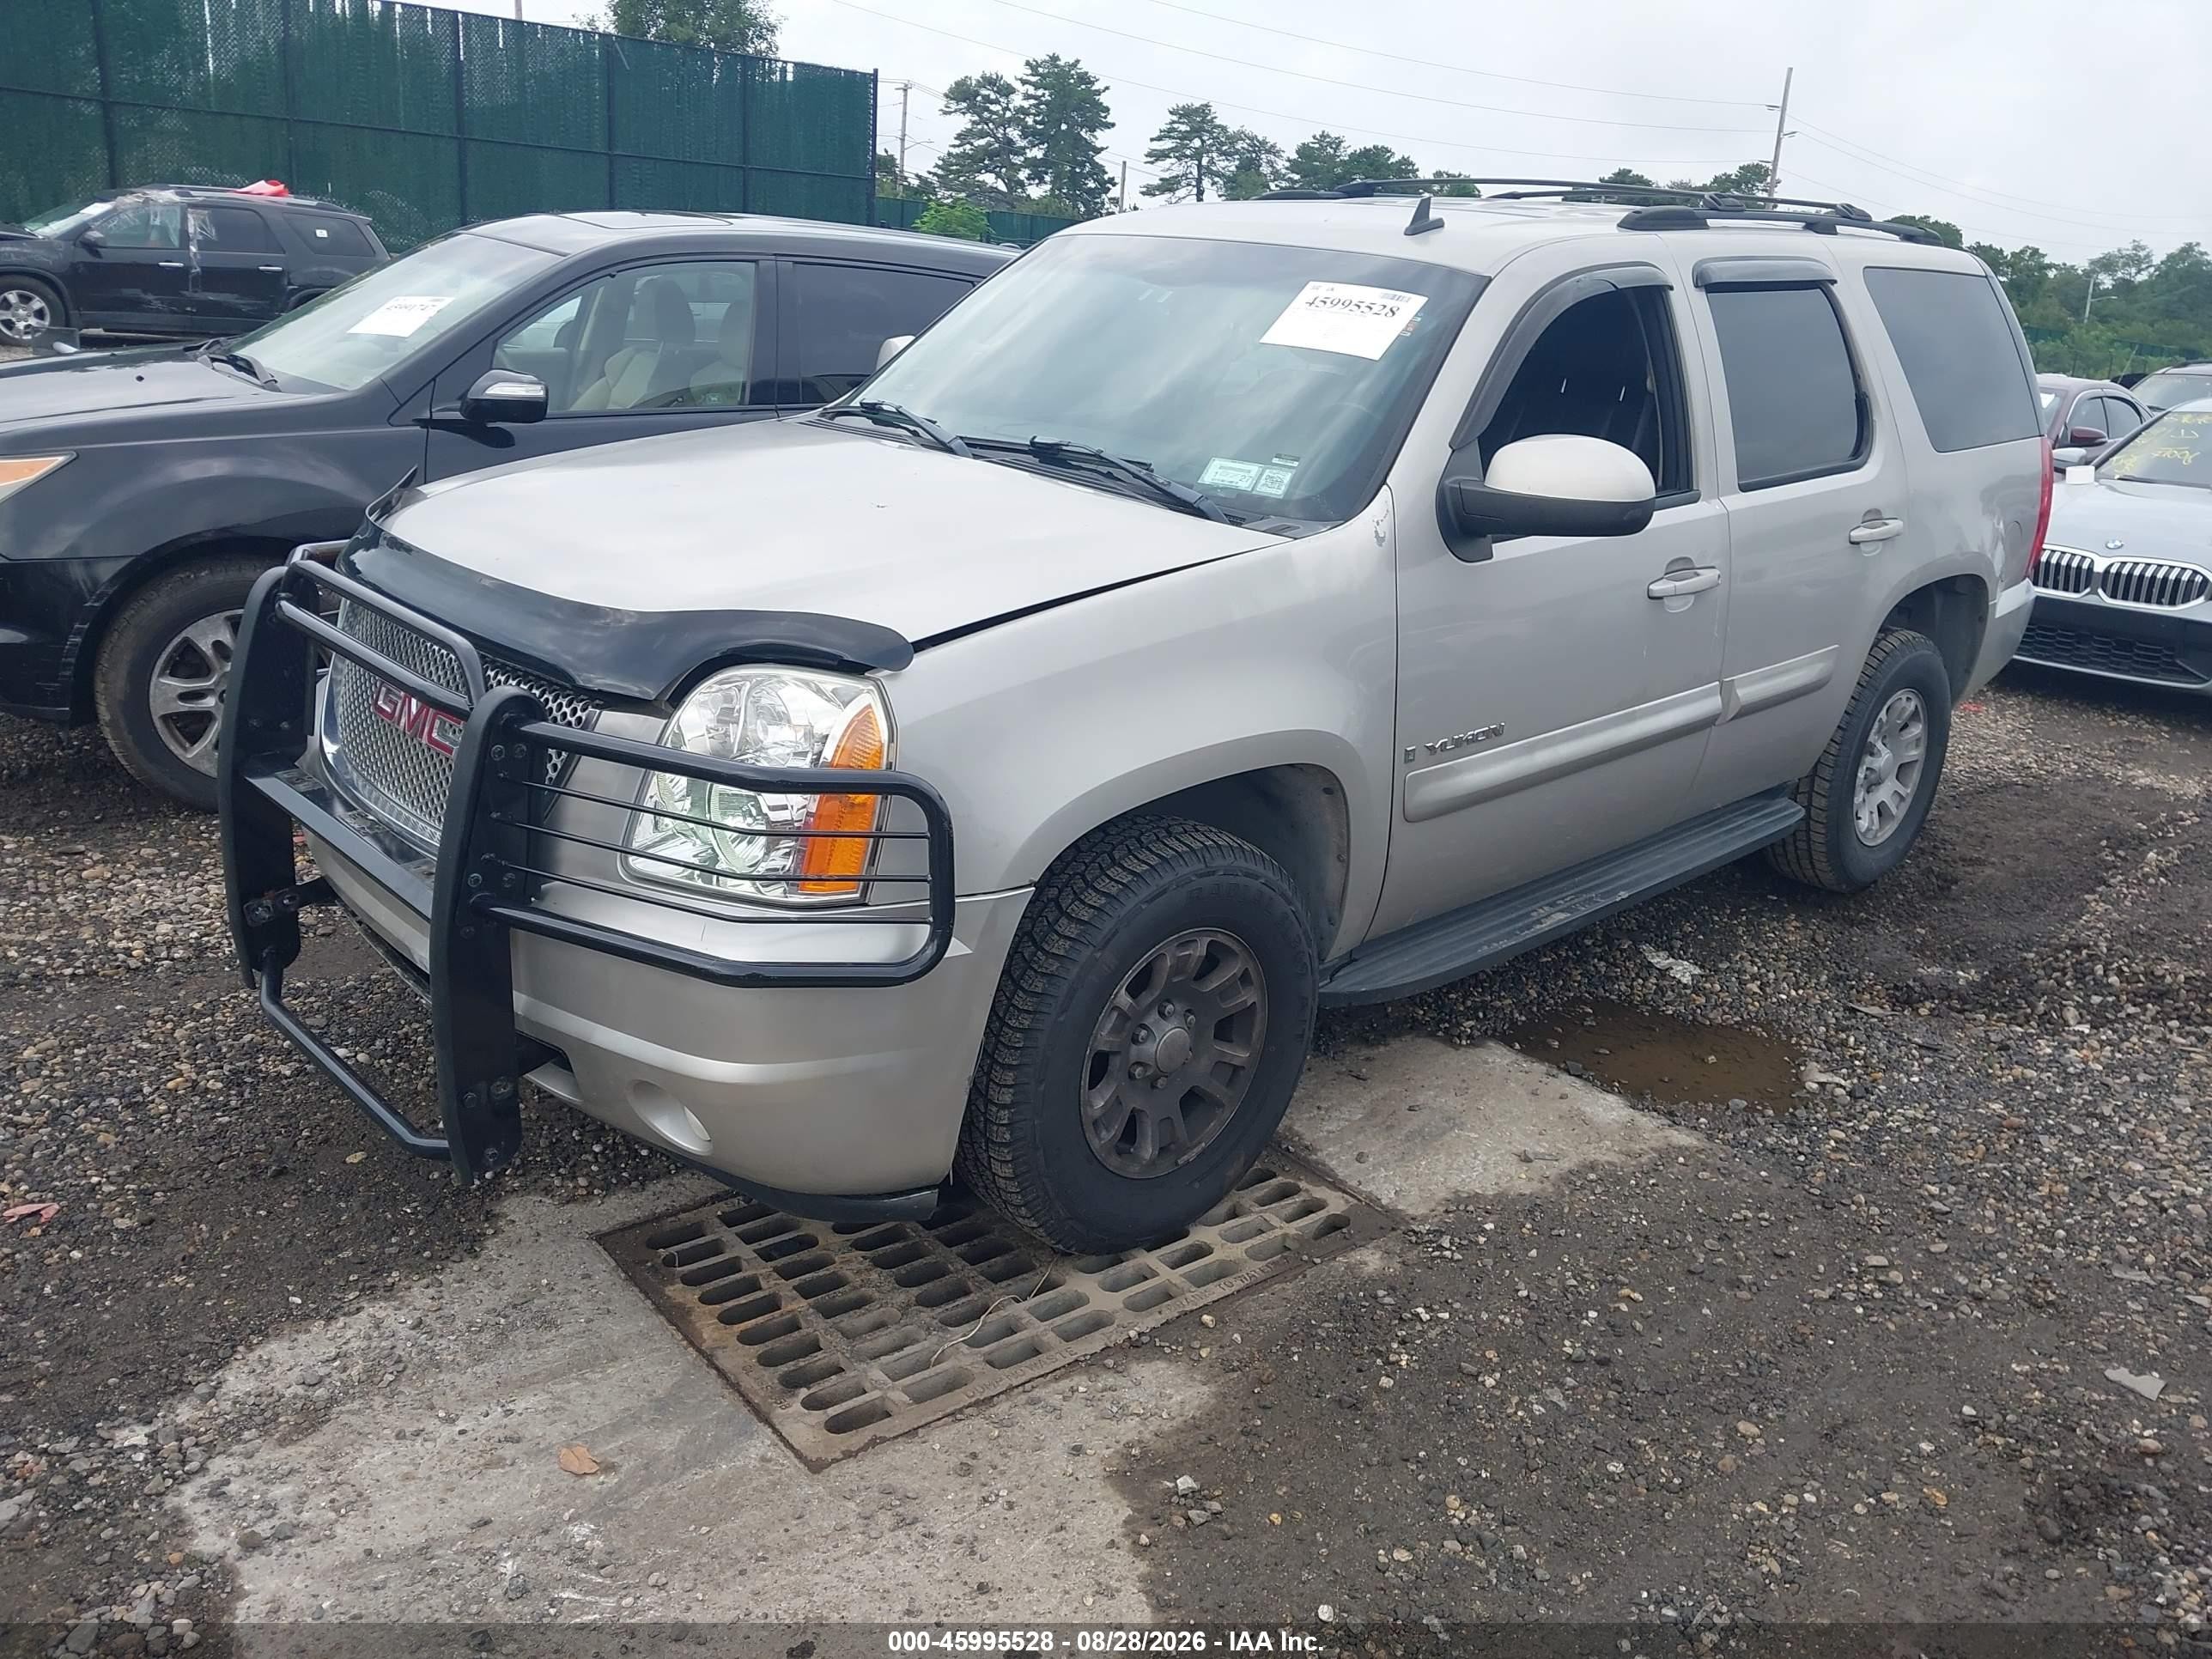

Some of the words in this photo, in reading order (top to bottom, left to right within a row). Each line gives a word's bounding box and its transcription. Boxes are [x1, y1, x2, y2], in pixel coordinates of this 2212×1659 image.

[1304, 295, 1401, 319] 45995528
[374, 684, 467, 757] GMC
[1424, 721, 1505, 756] YUKON
